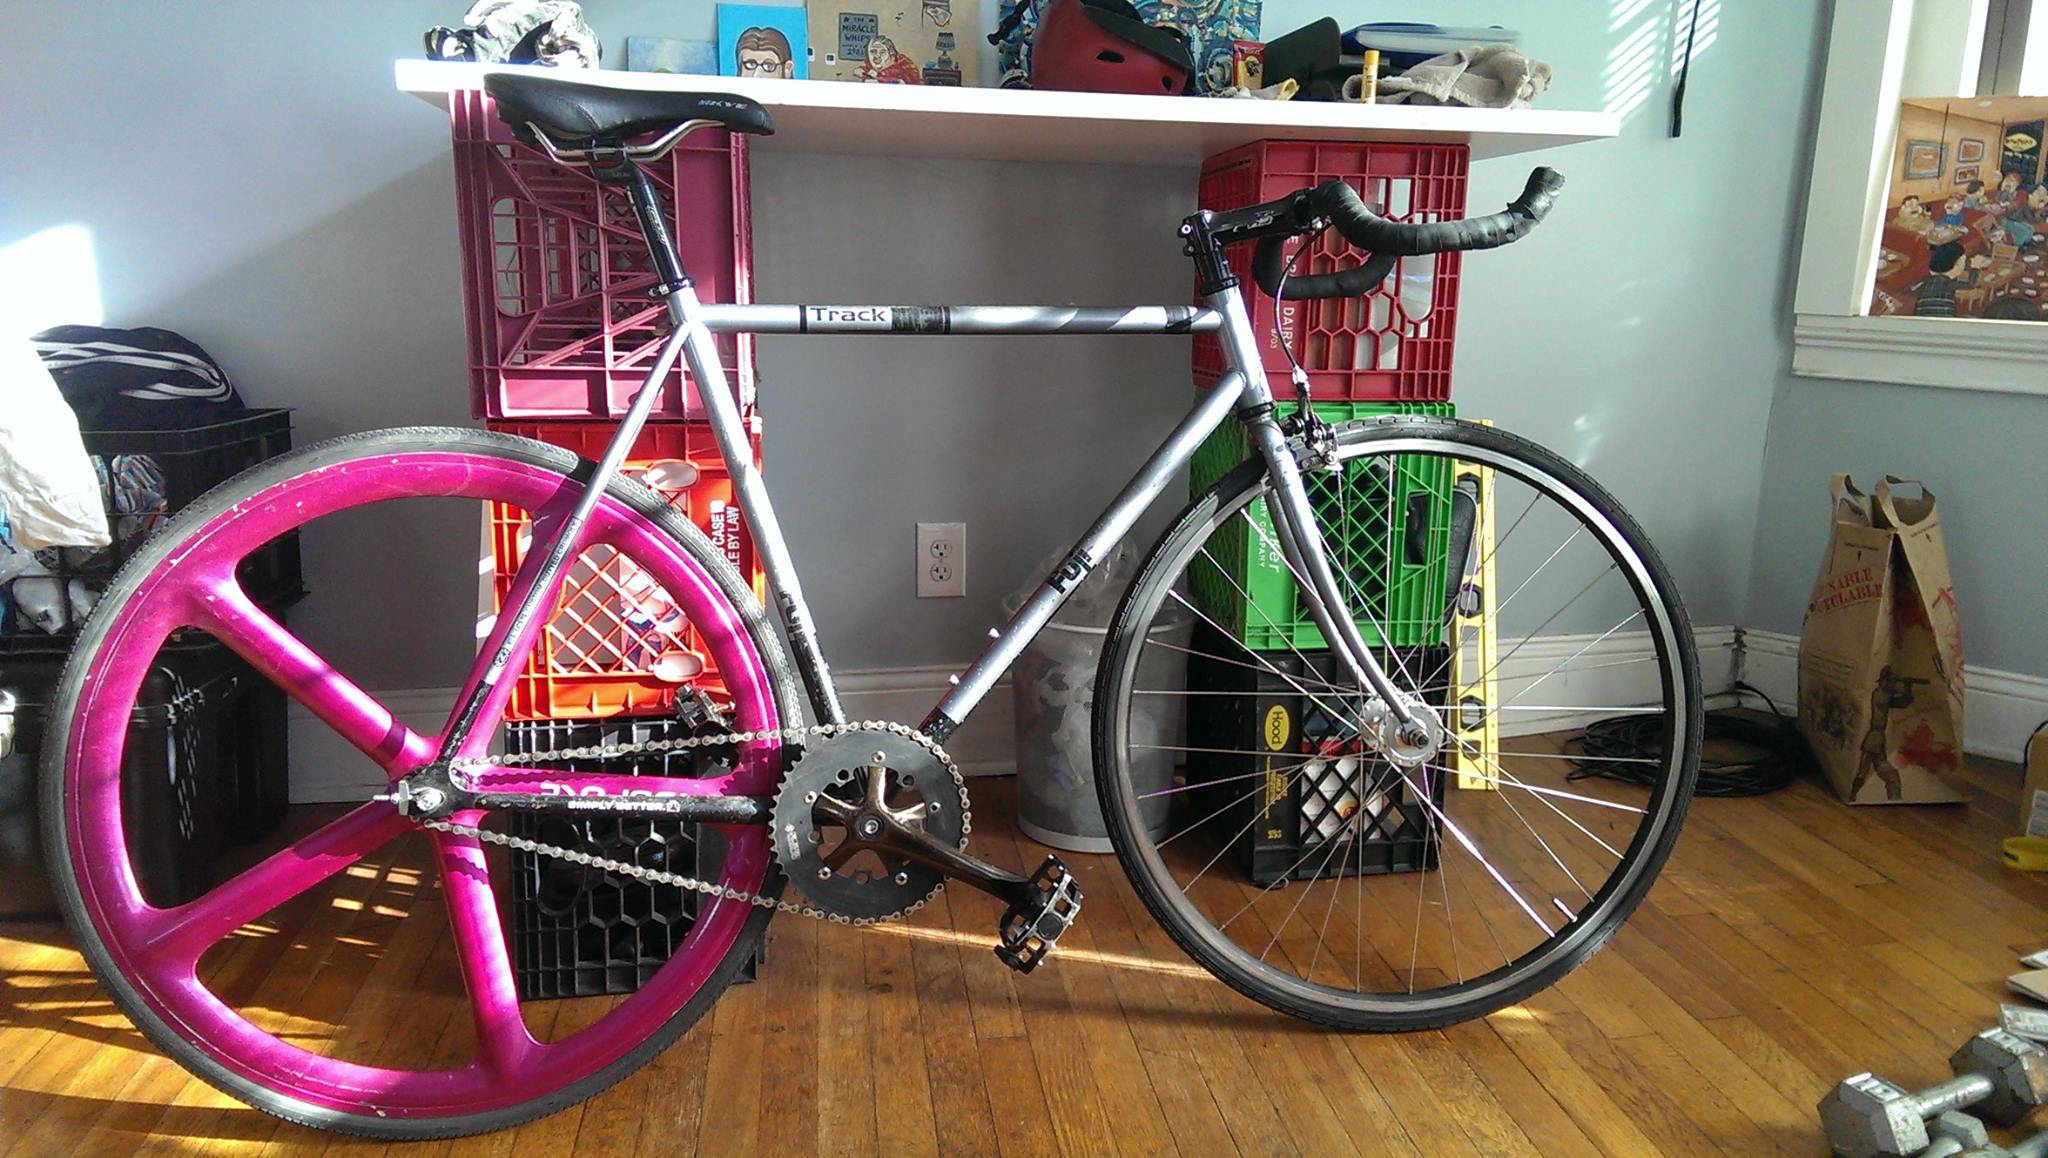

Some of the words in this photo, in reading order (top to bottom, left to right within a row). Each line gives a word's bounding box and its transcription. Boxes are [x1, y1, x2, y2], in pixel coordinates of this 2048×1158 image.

[842, 24, 876, 33] MIRACLE
[810, 307, 887, 322] Track
[1282, 307, 1295, 350] DAIRY
[1260, 495, 1268, 518] AIRY
[711, 512, 725, 545] CASE
[726, 506, 740, 532] LAW
[727, 533, 740, 549] BY
[1272, 711, 1284, 745] Hood
